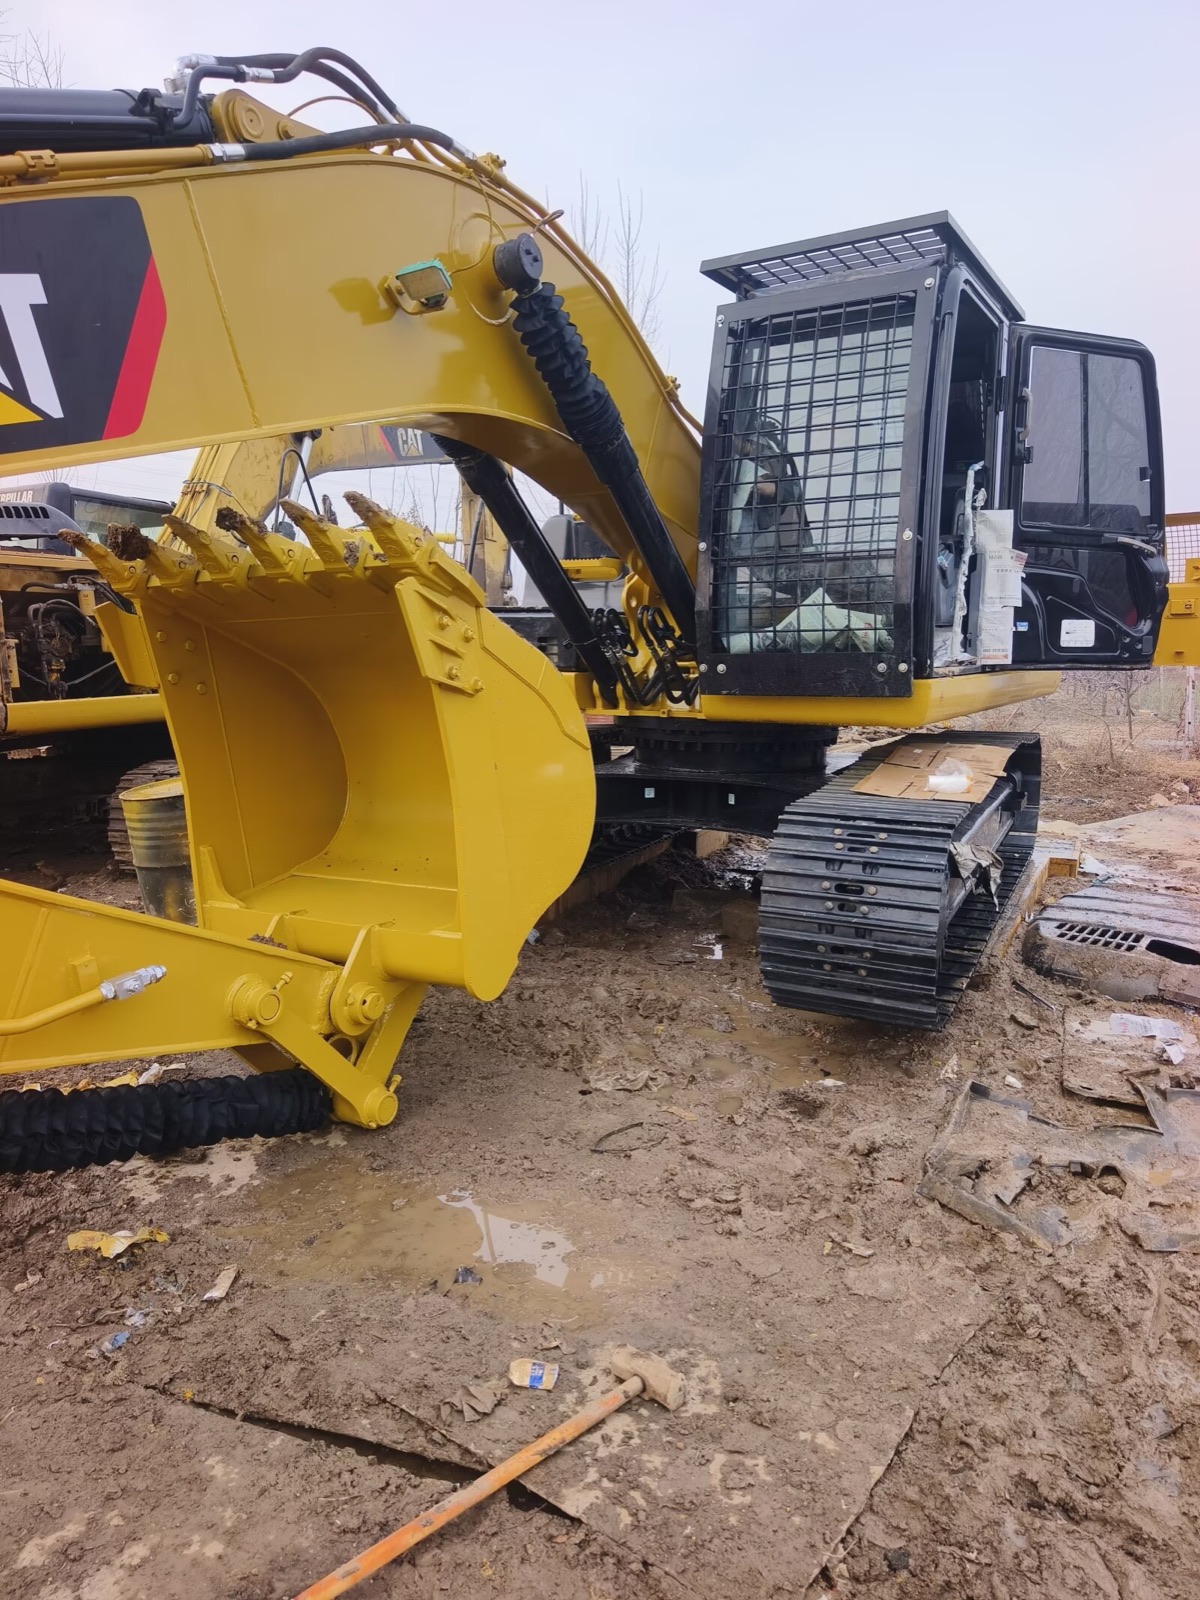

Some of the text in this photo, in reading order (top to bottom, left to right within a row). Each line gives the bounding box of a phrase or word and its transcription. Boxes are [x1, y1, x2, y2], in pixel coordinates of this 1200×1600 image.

[0, 274, 64, 419] T
[397, 428, 424, 457] CAT
[0, 490, 33, 503] RPILLAR
